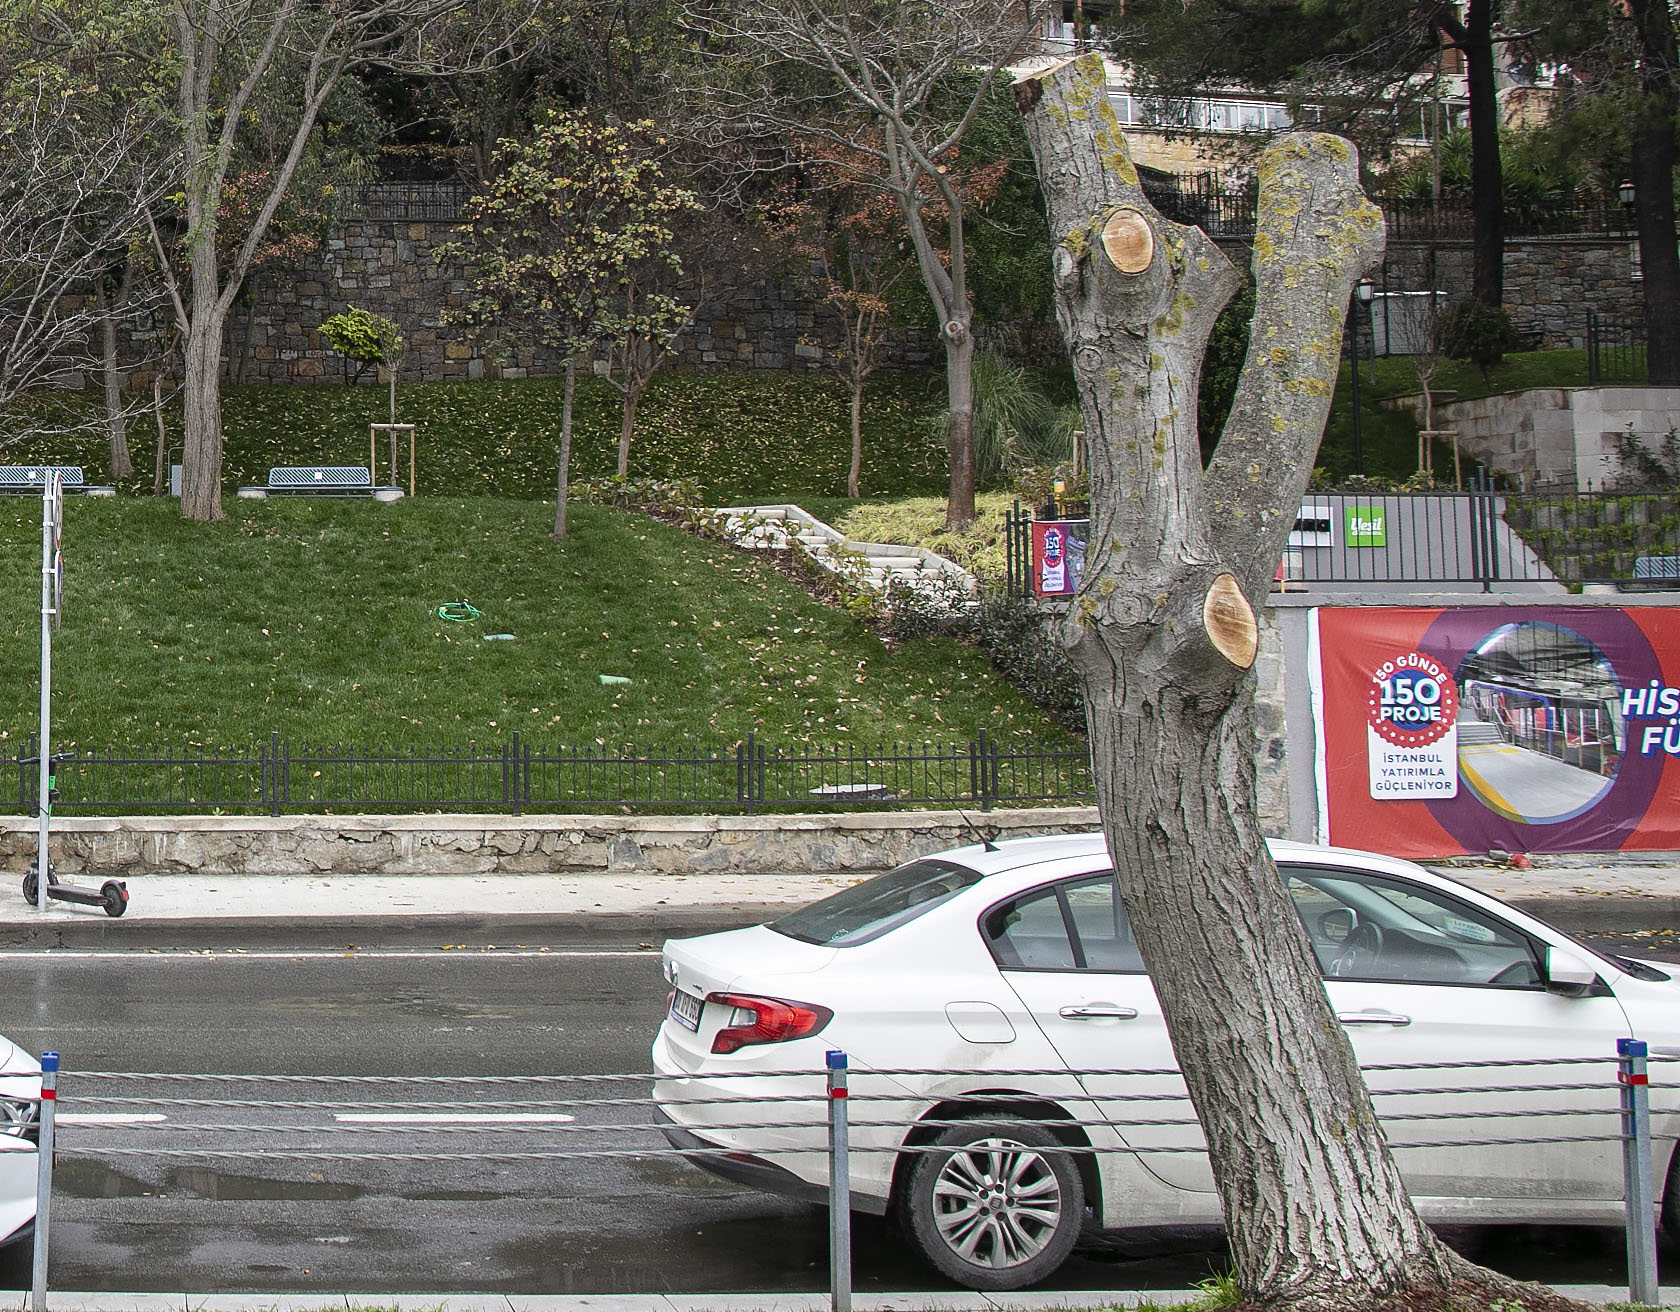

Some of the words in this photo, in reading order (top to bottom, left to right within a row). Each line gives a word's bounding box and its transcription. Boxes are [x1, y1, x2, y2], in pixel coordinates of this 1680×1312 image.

[1373, 661, 1394, 684] 150
[1396, 653, 1448, 685] GÜNDE
[1380, 678, 1441, 705] 150
[1622, 679, 1680, 715] HİS
[1380, 706, 1442, 721] PROJE
[1383, 753, 1443, 763] İSTANBUL
[1381, 768, 1445, 777] YATIRIMLA
[1375, 780, 1452, 792] GÜÇLENİYOR
